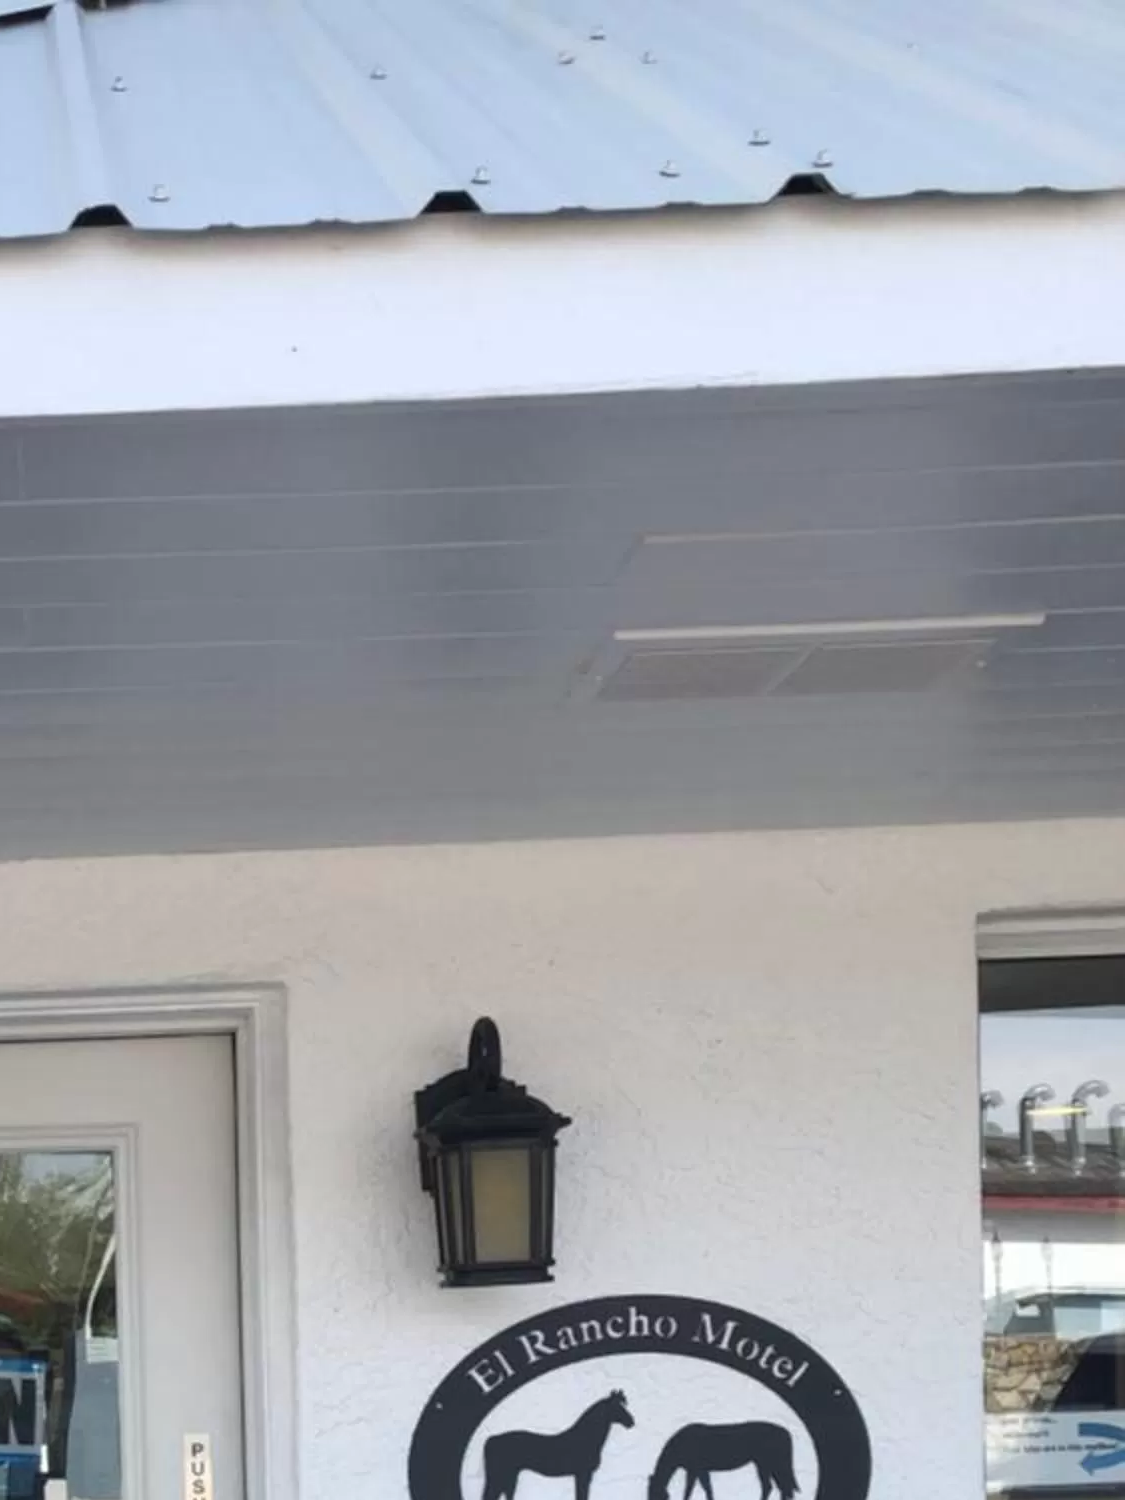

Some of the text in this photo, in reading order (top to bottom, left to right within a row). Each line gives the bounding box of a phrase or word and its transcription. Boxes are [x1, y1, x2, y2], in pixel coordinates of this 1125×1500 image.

[467, 1306, 810, 1394] El Rancho Motel
